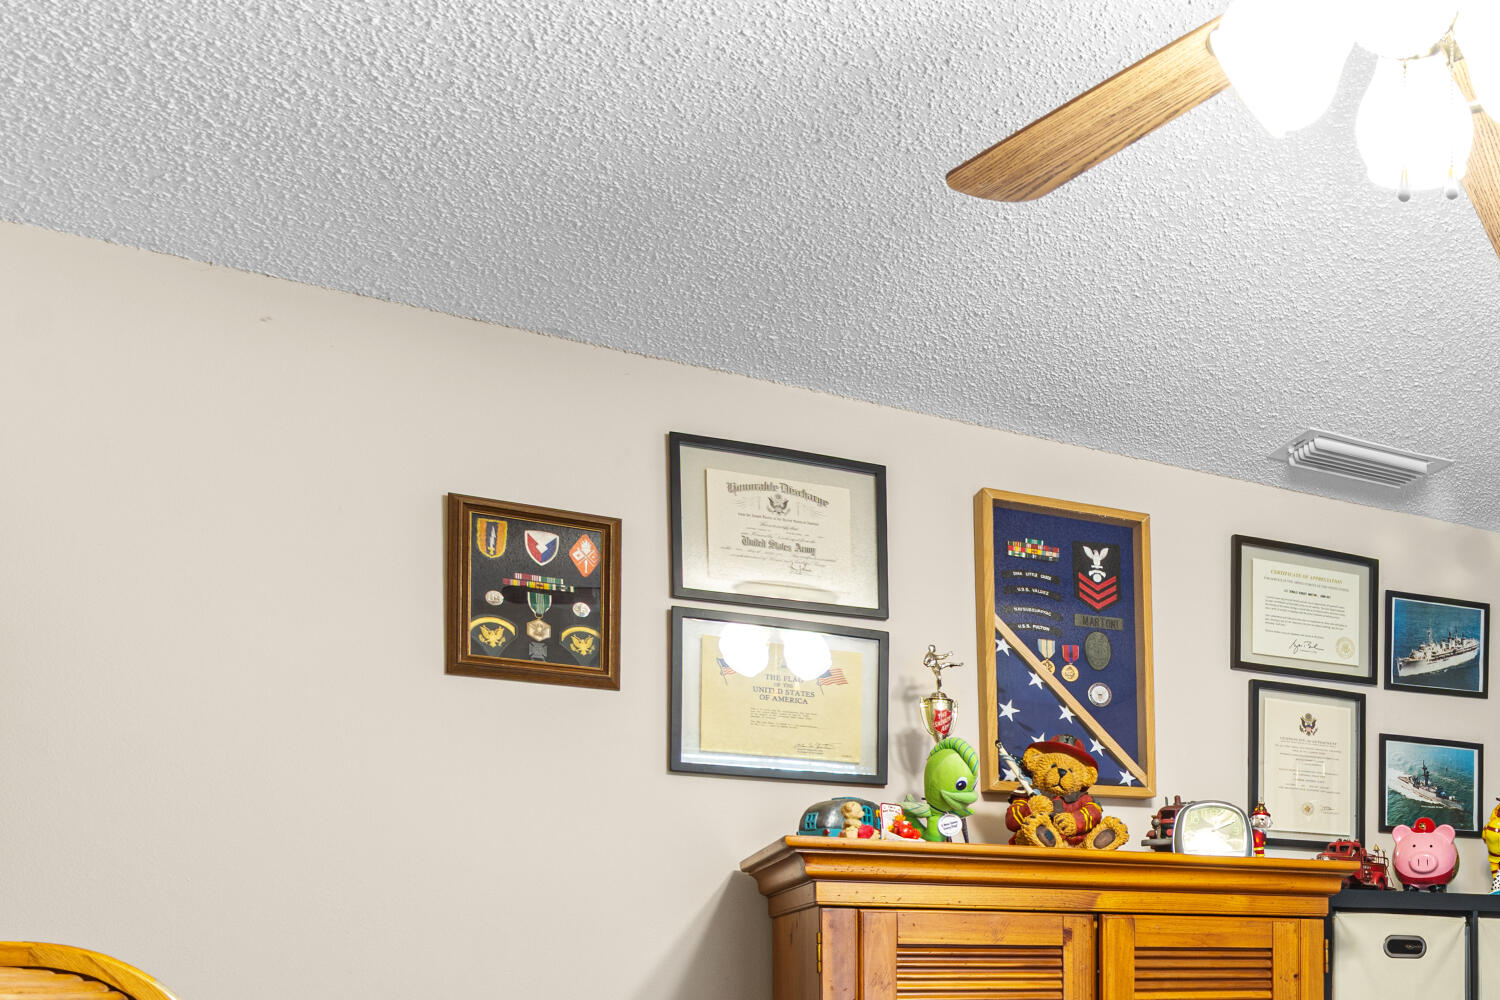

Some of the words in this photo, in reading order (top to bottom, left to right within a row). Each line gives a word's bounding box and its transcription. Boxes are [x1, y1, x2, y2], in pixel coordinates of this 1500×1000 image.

[752, 686, 783, 695] UNITD
[785, 689, 815, 698] STATES
[772, 695, 808, 705] AMERICA
